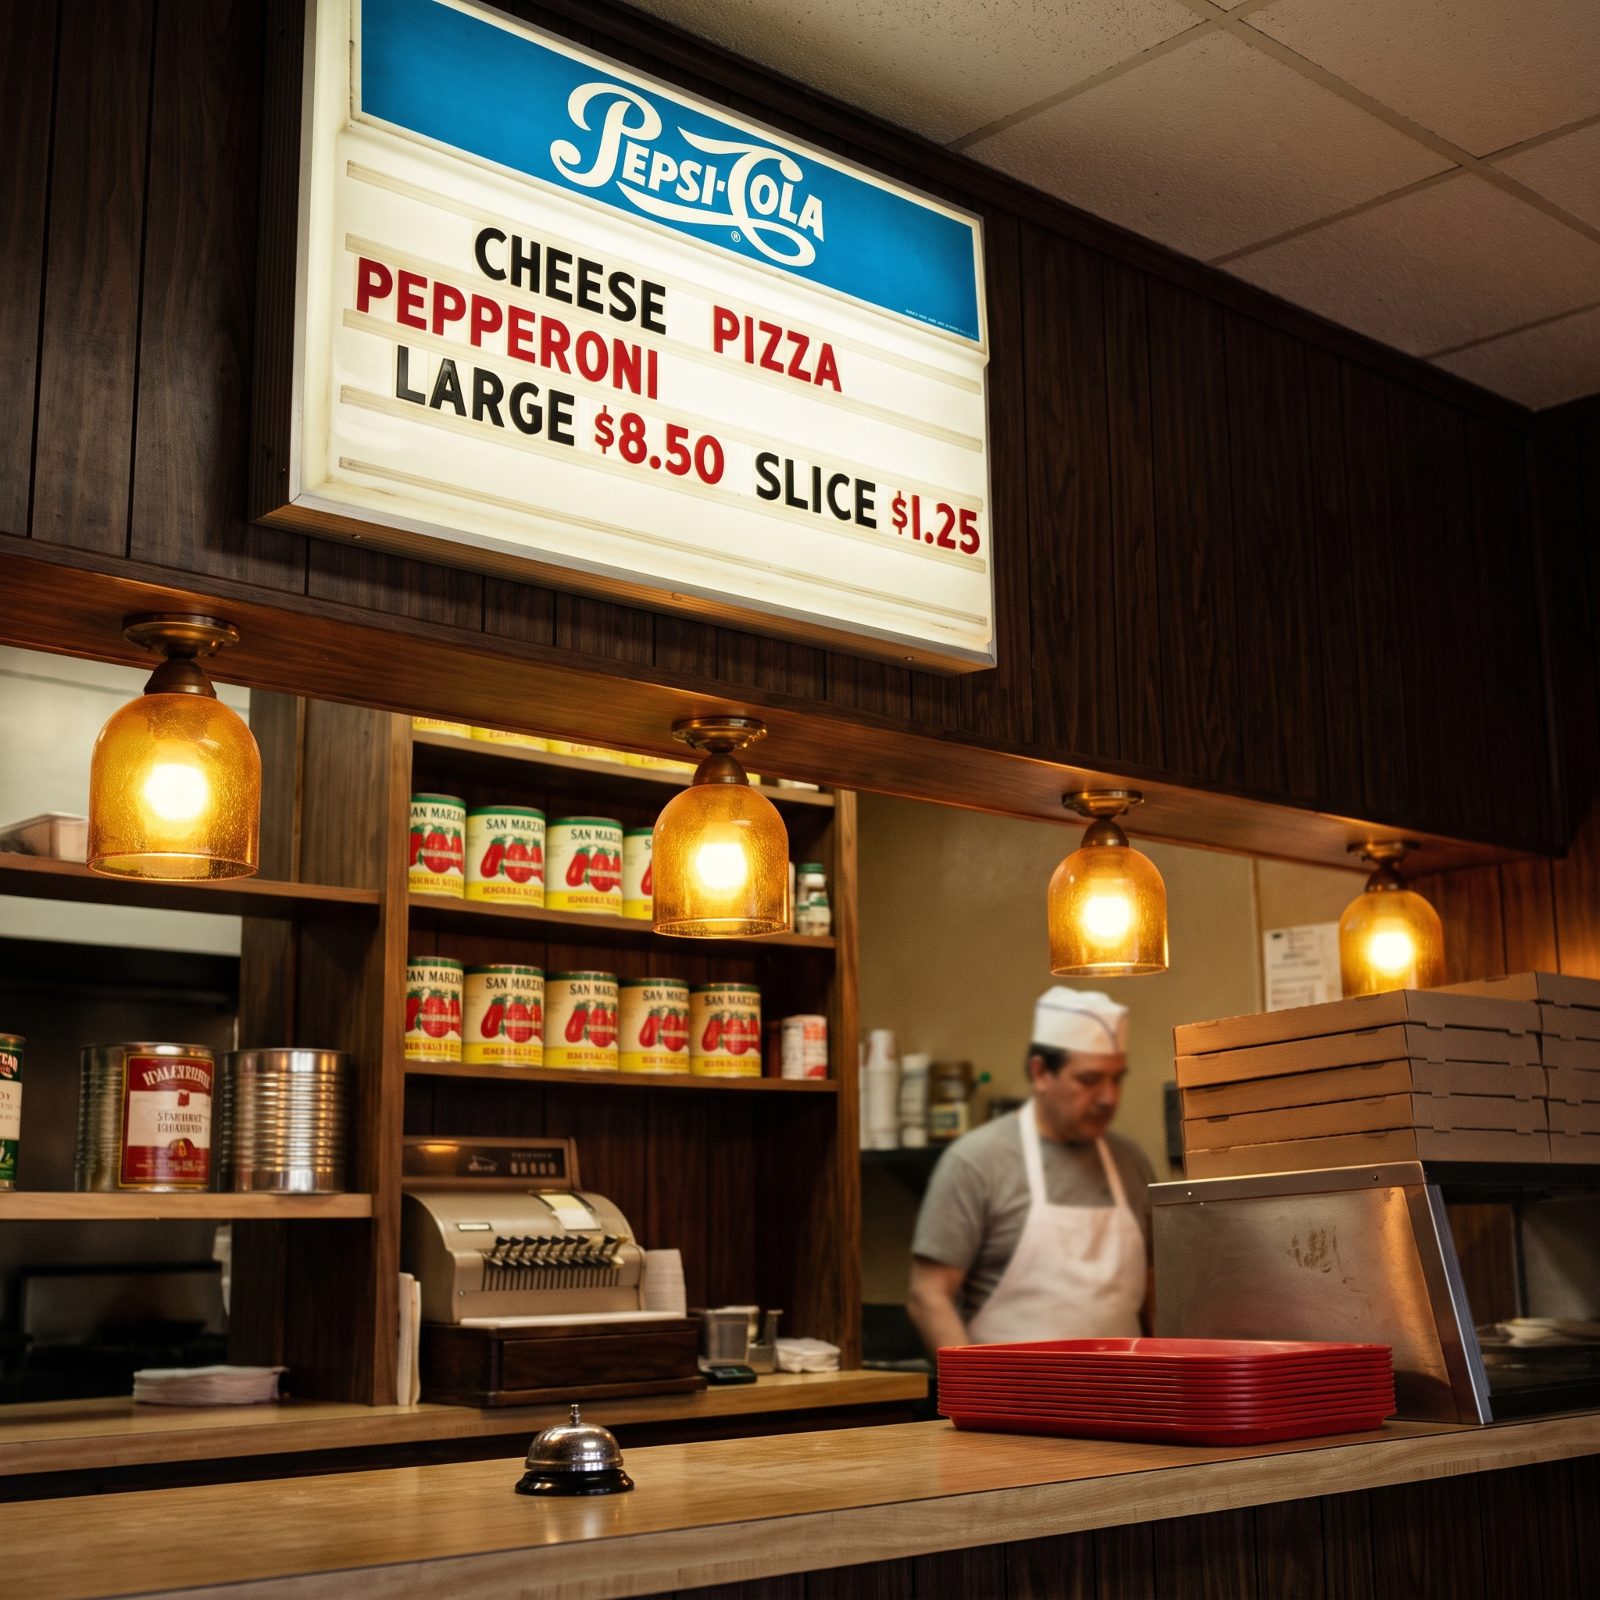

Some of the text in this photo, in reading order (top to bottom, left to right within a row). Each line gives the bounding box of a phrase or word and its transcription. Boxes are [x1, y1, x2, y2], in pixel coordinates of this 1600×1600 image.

[474, 227, 843, 393] CHEESE PIZZA
[356, 257, 659, 400] PEPPERONI
[396, 344, 981, 555] LARGE $8.50 SLICE $1.25
[486, 818, 508, 830] SAN
[571, 828, 592, 841] SAN
[486, 977, 508, 990] SAN
[570, 983, 591, 996] SAN
